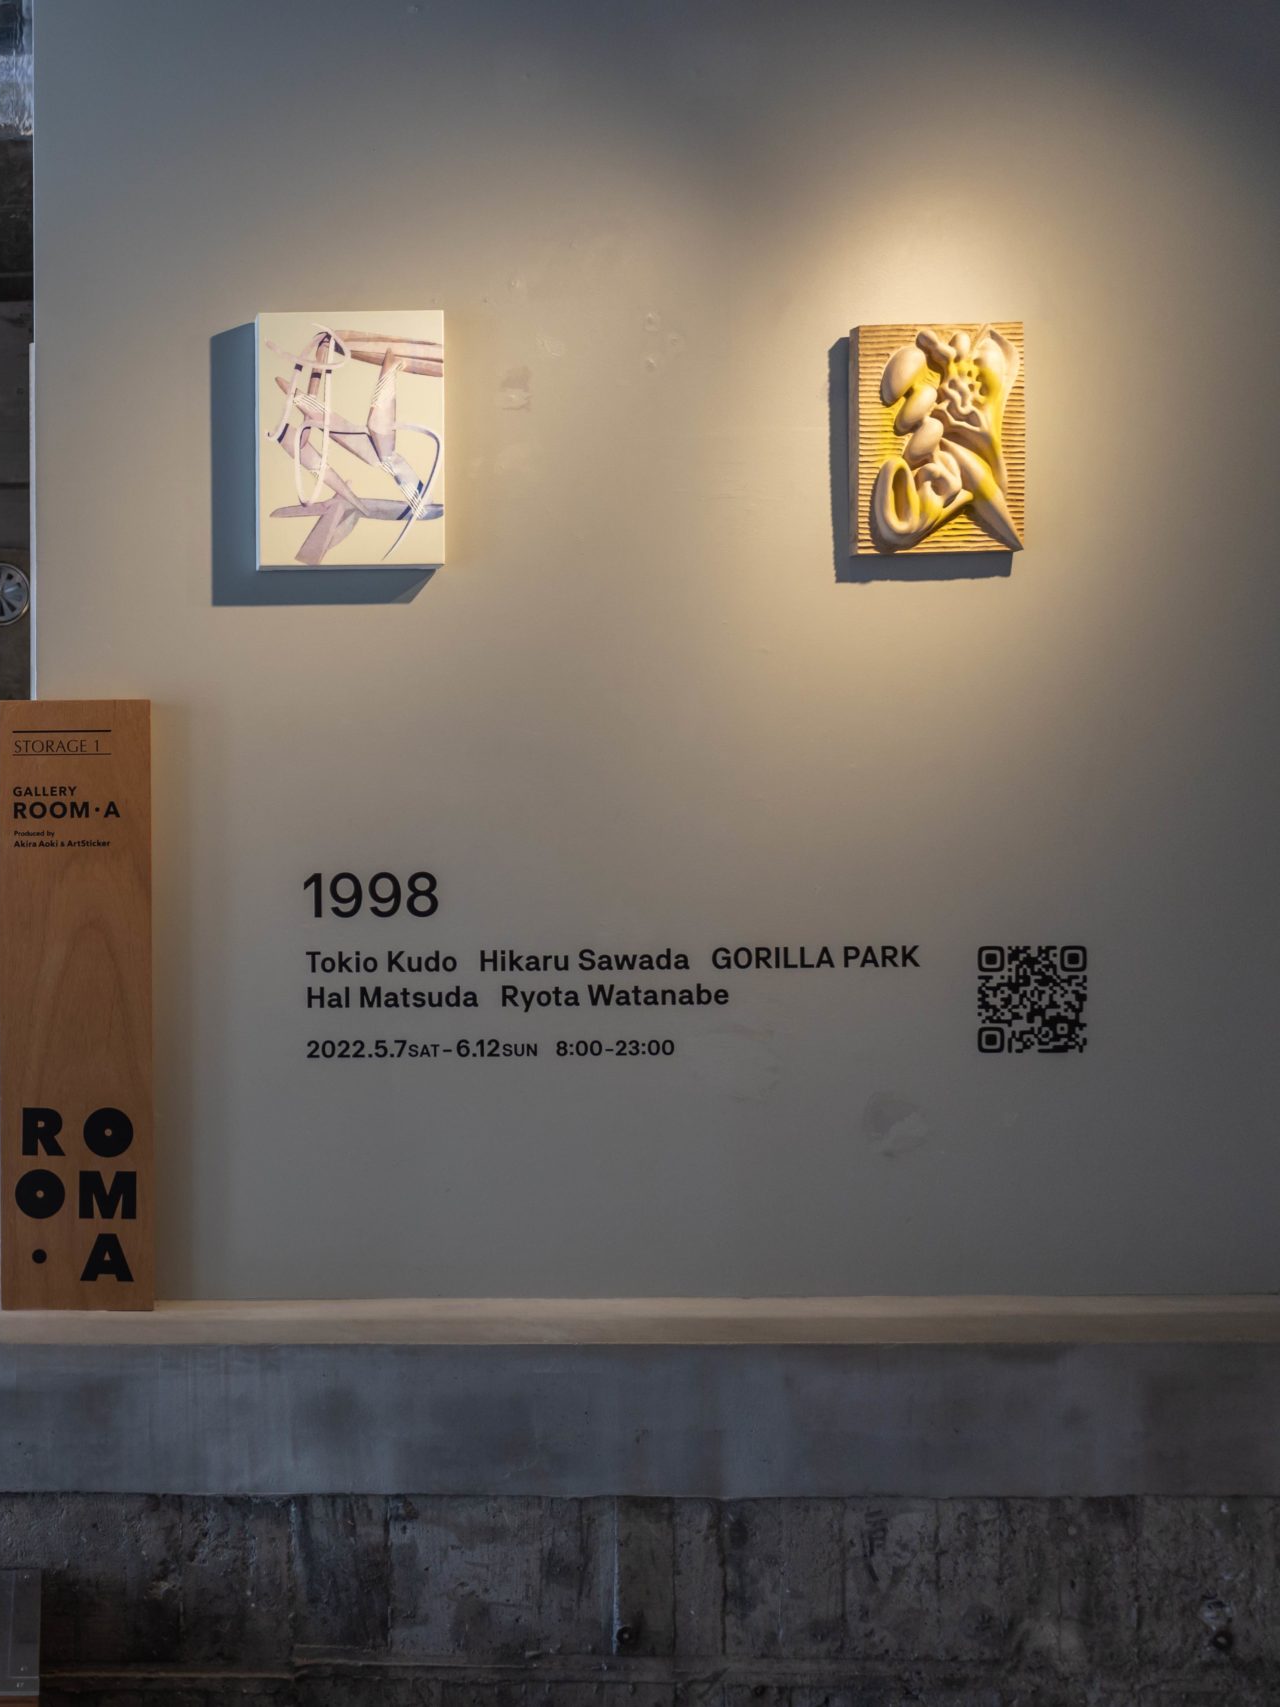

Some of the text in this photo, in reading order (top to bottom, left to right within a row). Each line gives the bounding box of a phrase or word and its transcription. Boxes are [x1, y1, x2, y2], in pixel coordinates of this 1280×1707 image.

[14, 739, 99, 753] STORAGE 1
[12, 786, 77, 797] GALLERY
[46, 830, 55, 838] by
[13, 840, 37, 848] Akira
[38, 840, 58, 848] Aoki
[66, 839, 111, 848] ArtSticker
[303, 872, 439, 918] 1998
[305, 945, 921, 973] Tokio Kudo Hikaru Sawada GORILLA PARK
[307, 983, 729, 1013] Hal Matsuda Ryota Watanabe
[555, 1040, 675, 1057] 8:00-23:00
